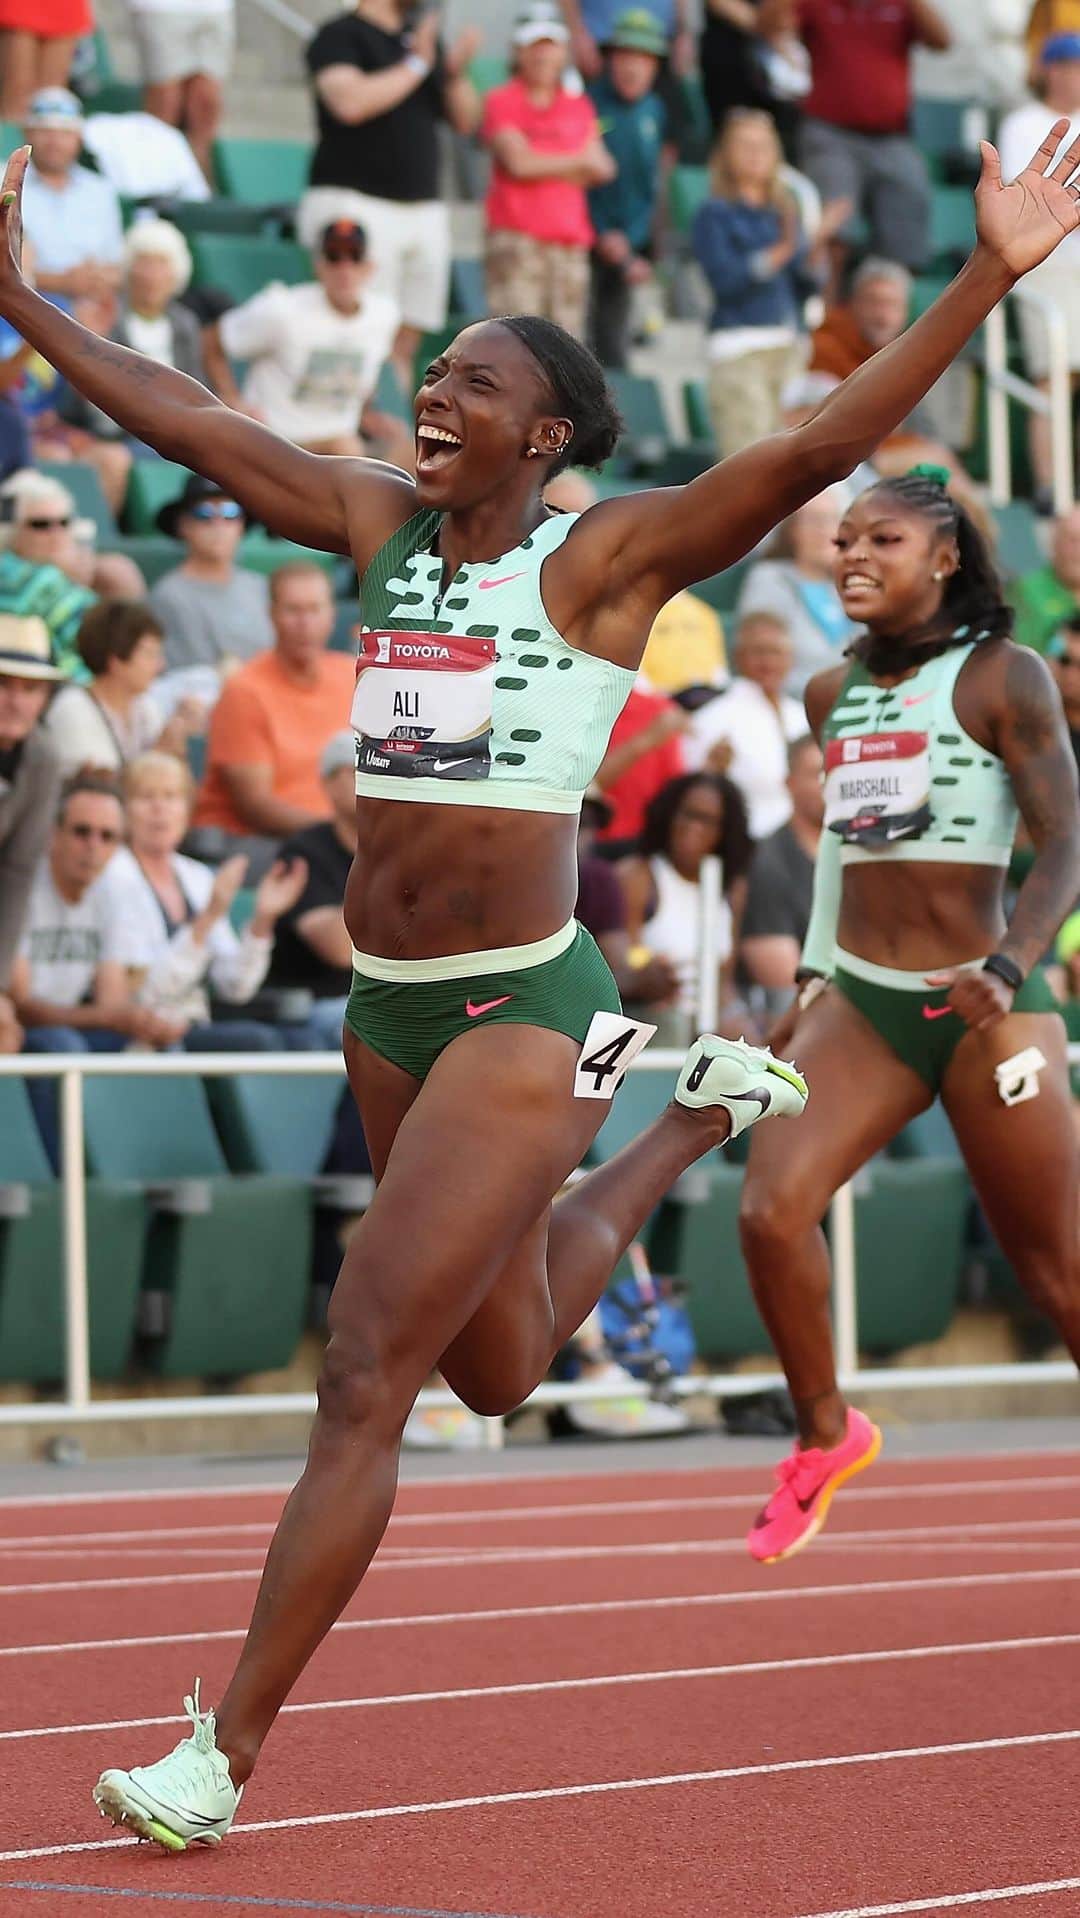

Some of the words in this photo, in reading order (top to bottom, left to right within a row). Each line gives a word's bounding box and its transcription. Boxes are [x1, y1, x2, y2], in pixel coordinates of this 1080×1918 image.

[394, 644, 450, 659] TOYOTA
[393, 691, 419, 717] ALI
[840, 776, 902, 800] MARSHALL
[580, 1028, 638, 1091] 4
